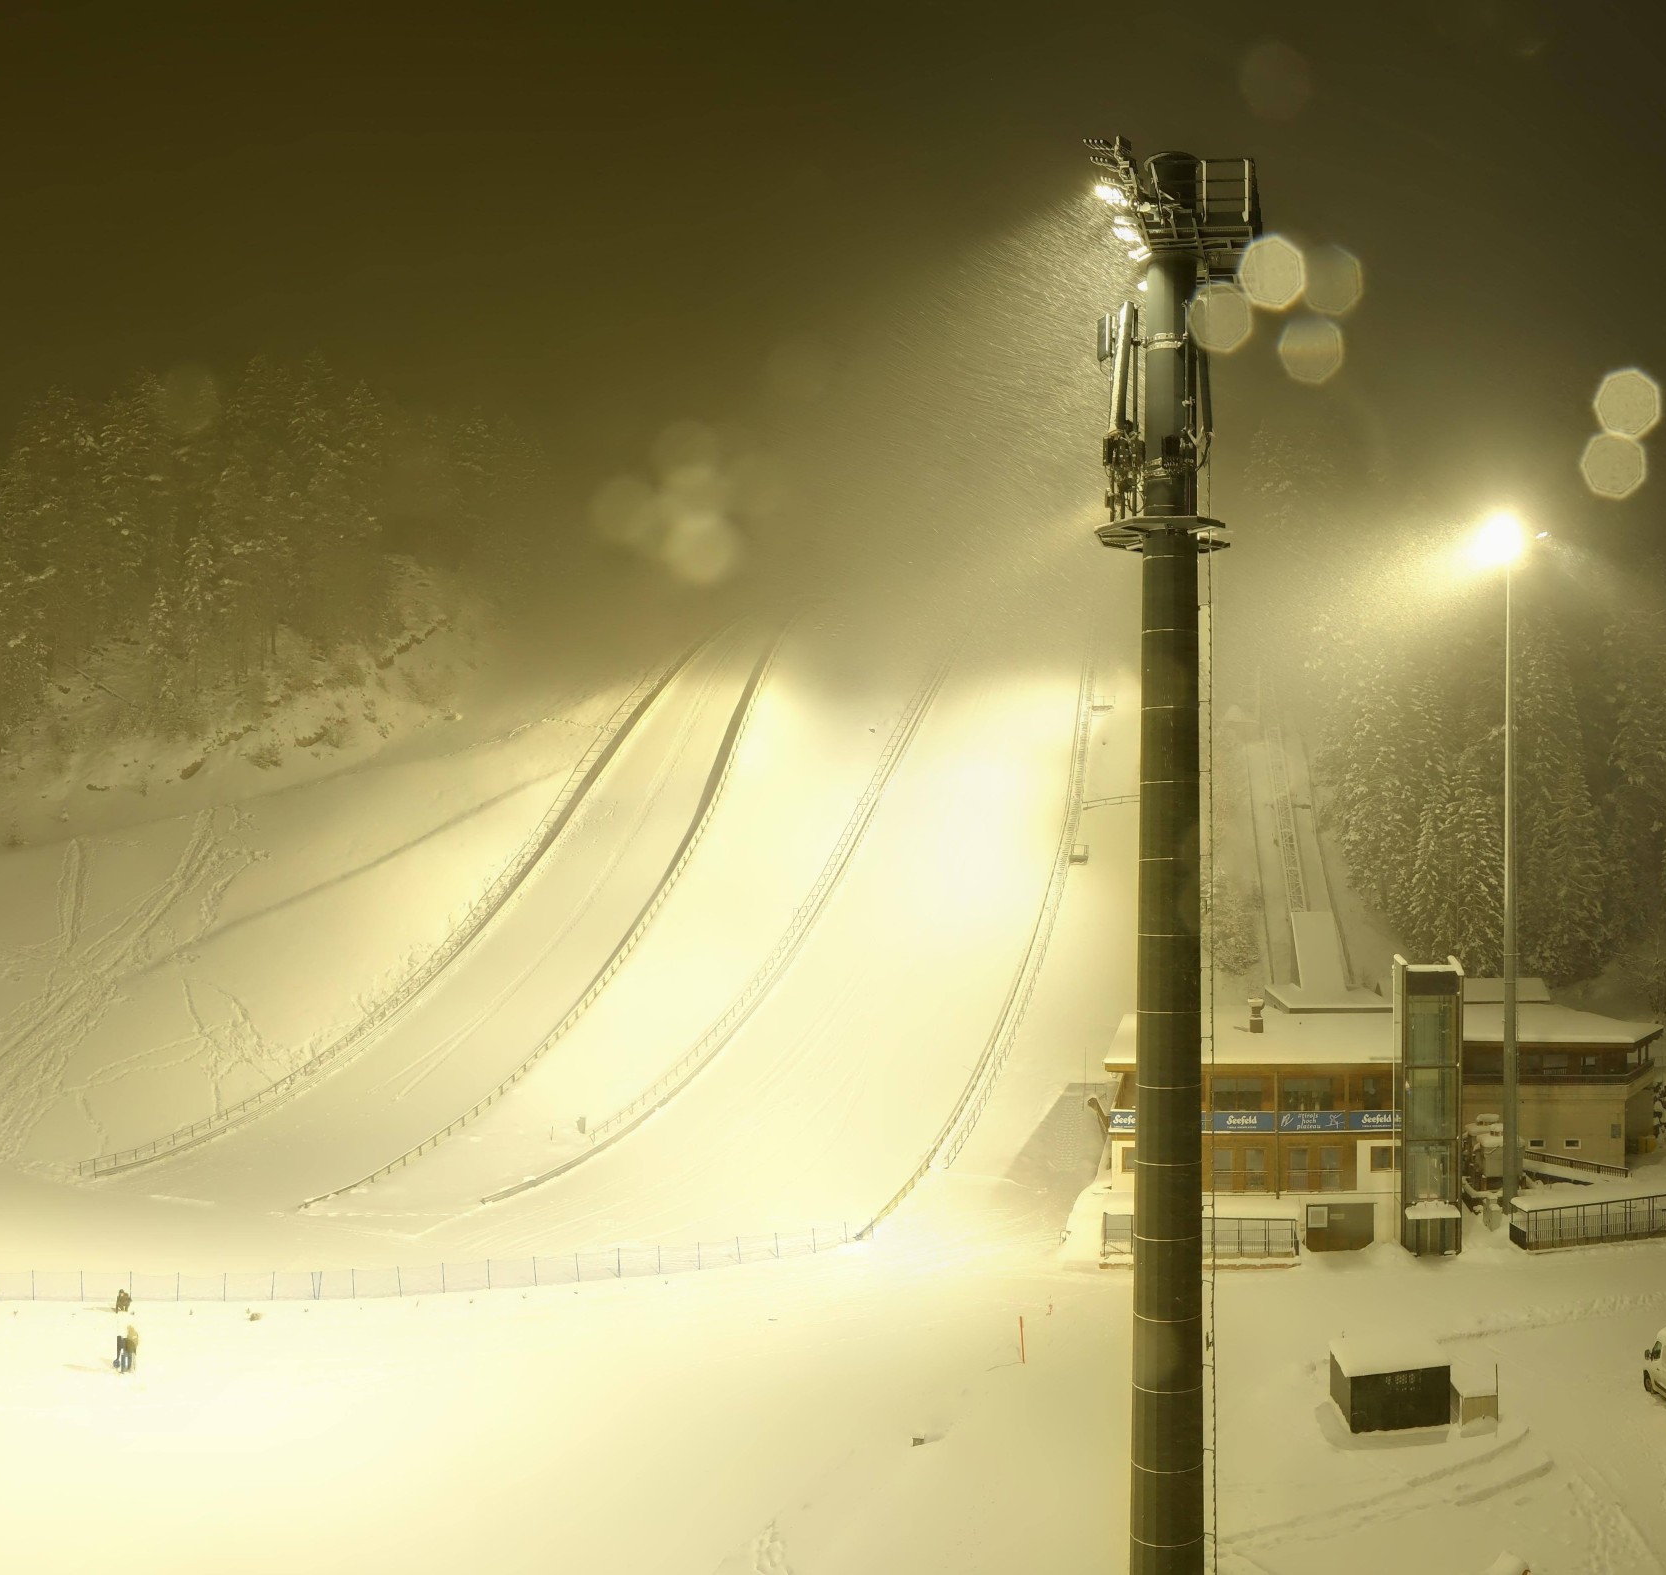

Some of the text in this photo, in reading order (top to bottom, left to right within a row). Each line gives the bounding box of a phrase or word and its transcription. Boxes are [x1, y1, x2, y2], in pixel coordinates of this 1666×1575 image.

[1113, 1114, 1136, 1125] Seefe
[1226, 1114, 1257, 1126] Seefeld
[1361, 1113, 1392, 1124] Seefeld
